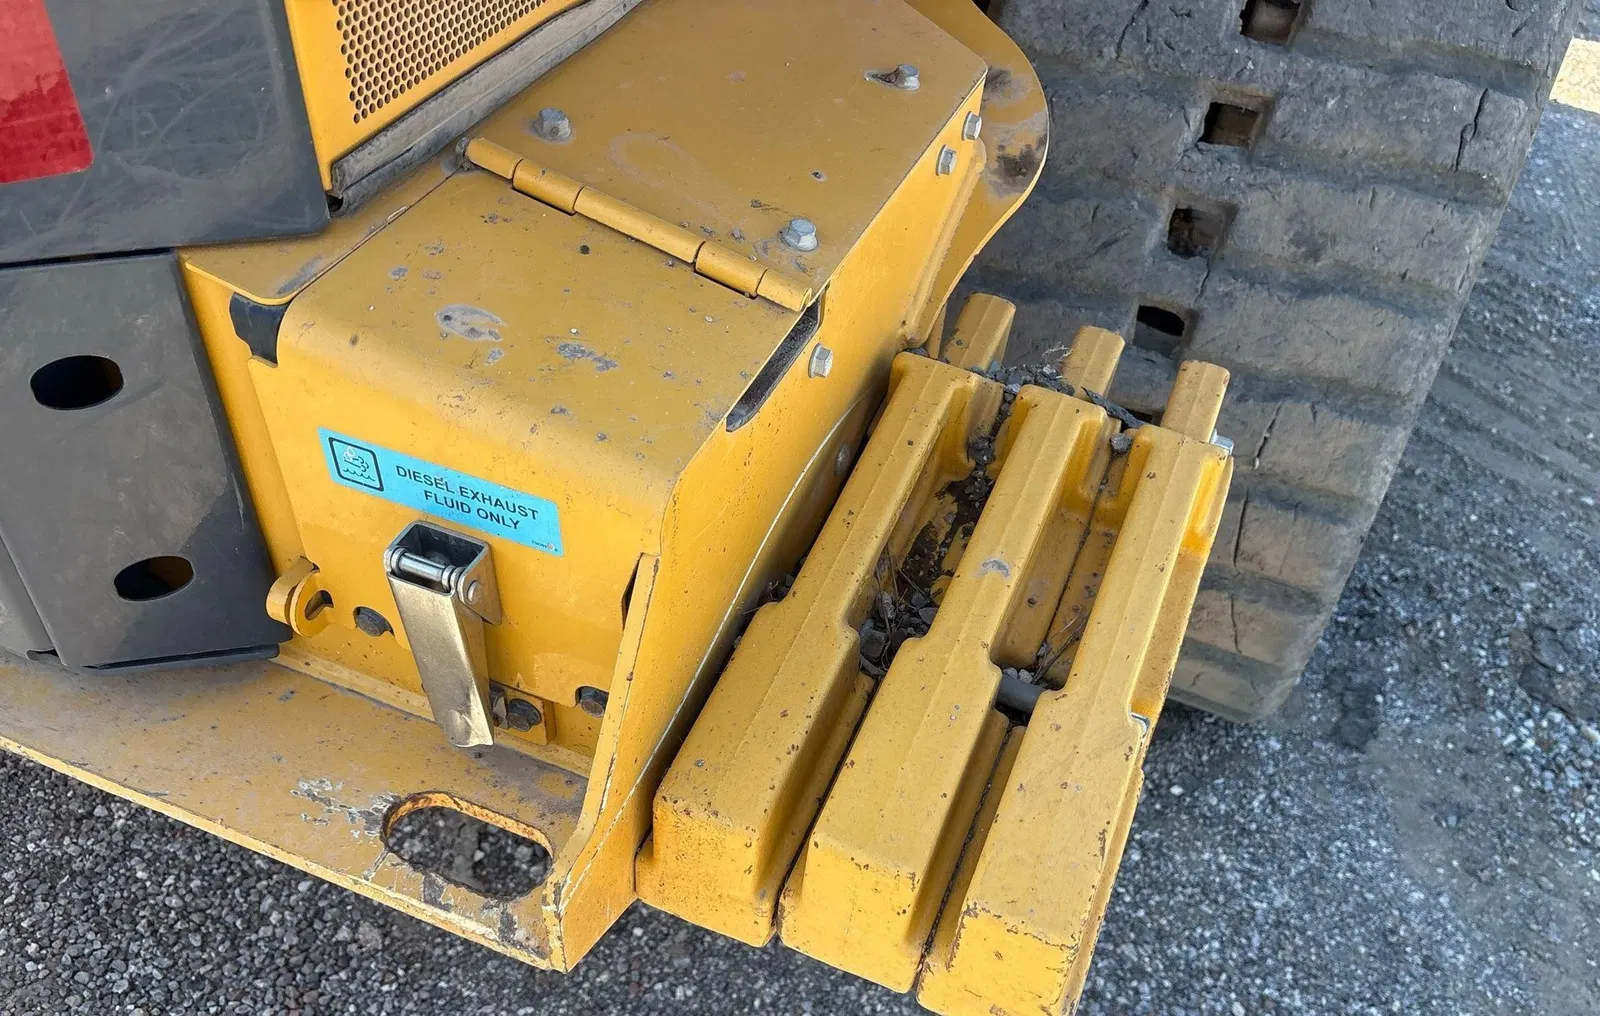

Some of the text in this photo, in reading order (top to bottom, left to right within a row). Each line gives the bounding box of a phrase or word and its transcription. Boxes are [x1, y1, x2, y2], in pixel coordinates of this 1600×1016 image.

[396, 465, 538, 520] DIESEL EXHAUST
[424, 490, 519, 529] FLUID ONLY
